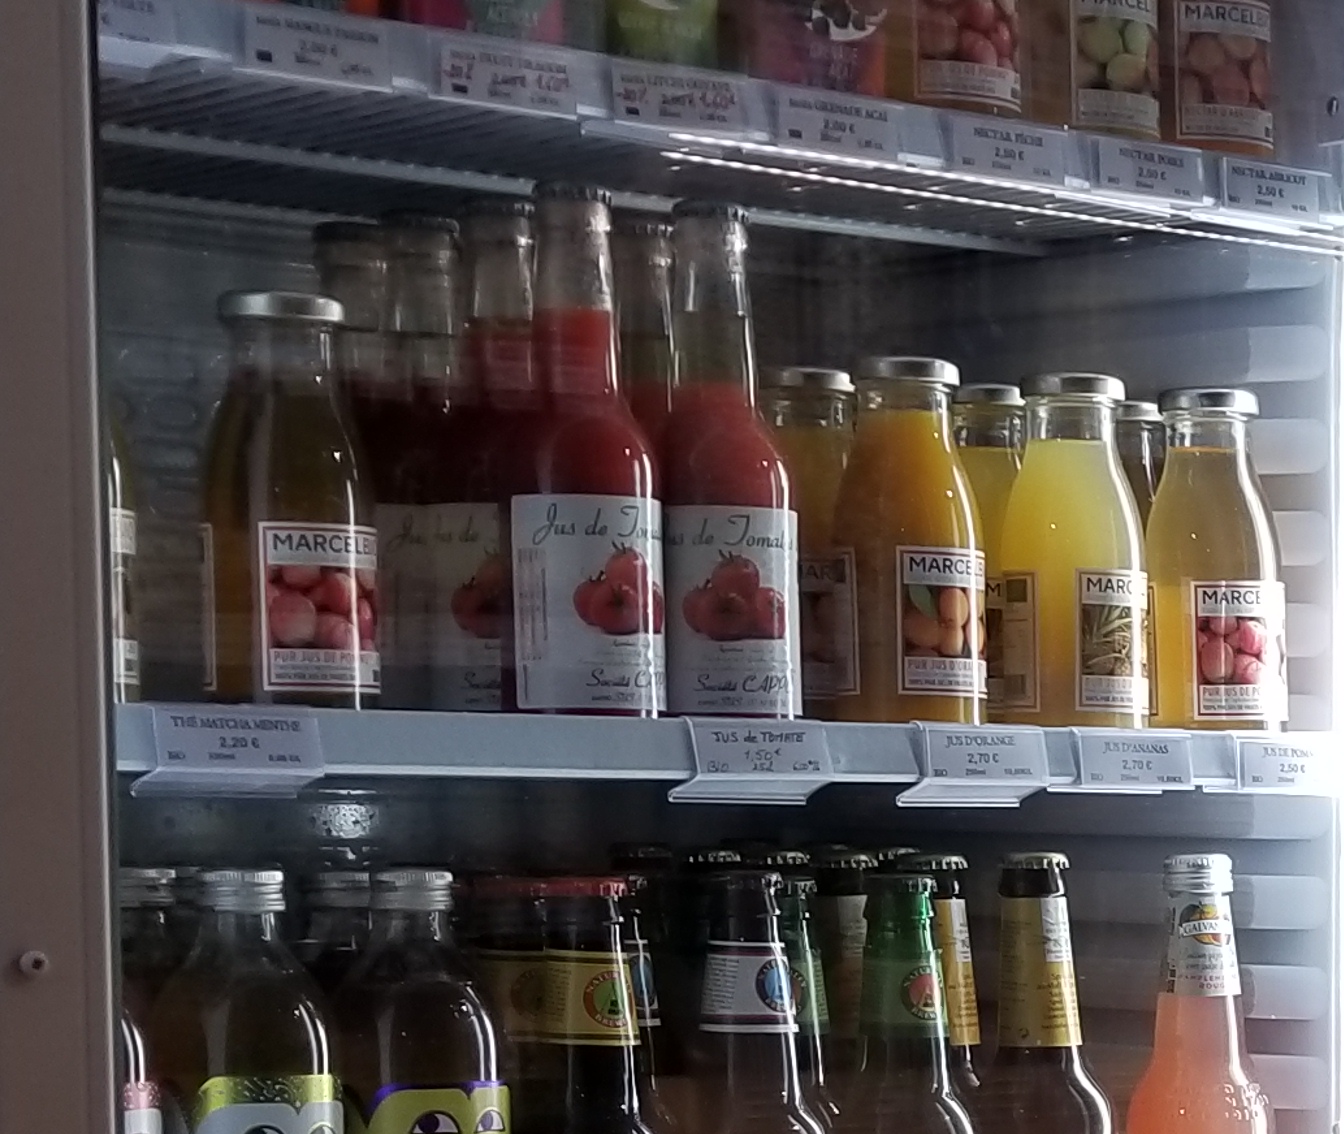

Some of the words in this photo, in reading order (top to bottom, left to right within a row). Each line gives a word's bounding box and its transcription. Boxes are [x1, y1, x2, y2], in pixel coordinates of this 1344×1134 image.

[532, 503, 576, 545] Jus
[584, 508, 608, 536] de
[692, 519, 714, 546] de
[712, 731, 738, 742] JUS
[760, 732, 806, 742] TOMATE
[967, 752, 991, 764] 2,70
[1123, 759, 1142, 770] 2,70
[1280, 763, 1297, 774] 2,50
